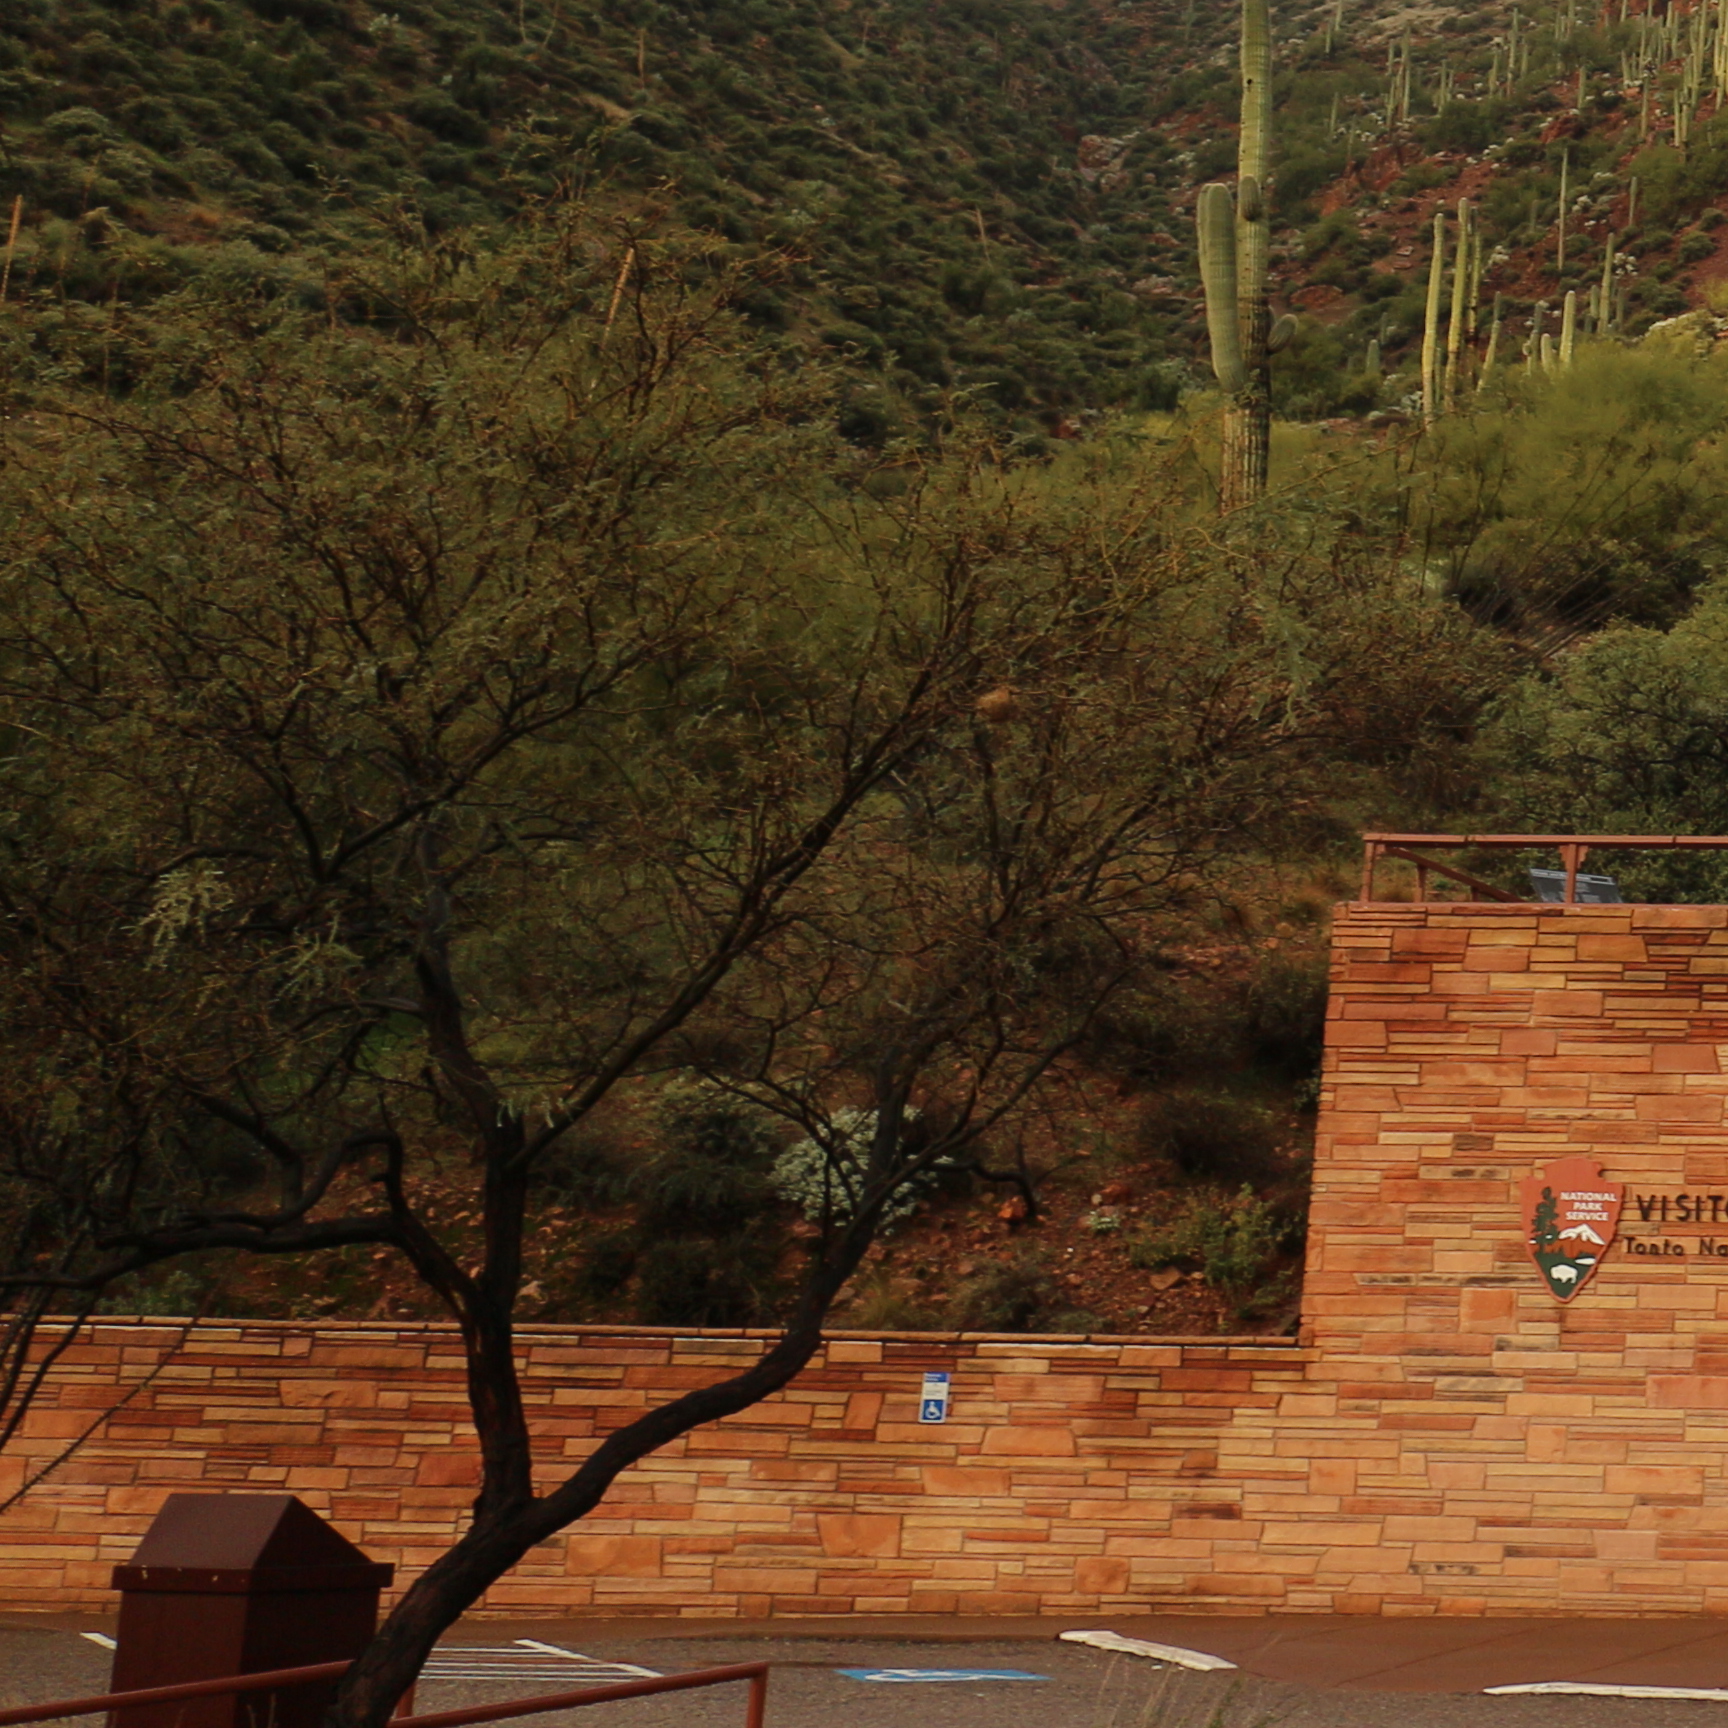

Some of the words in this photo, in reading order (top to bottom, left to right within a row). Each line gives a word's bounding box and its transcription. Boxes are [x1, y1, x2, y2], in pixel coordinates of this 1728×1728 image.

[1560, 1191, 1617, 1202] NATIONAL
[1573, 1201, 1603, 1211] PARK
[1565, 1211, 1609, 1221] SERVICE
[1625, 1237, 1684, 1256] Tonto
